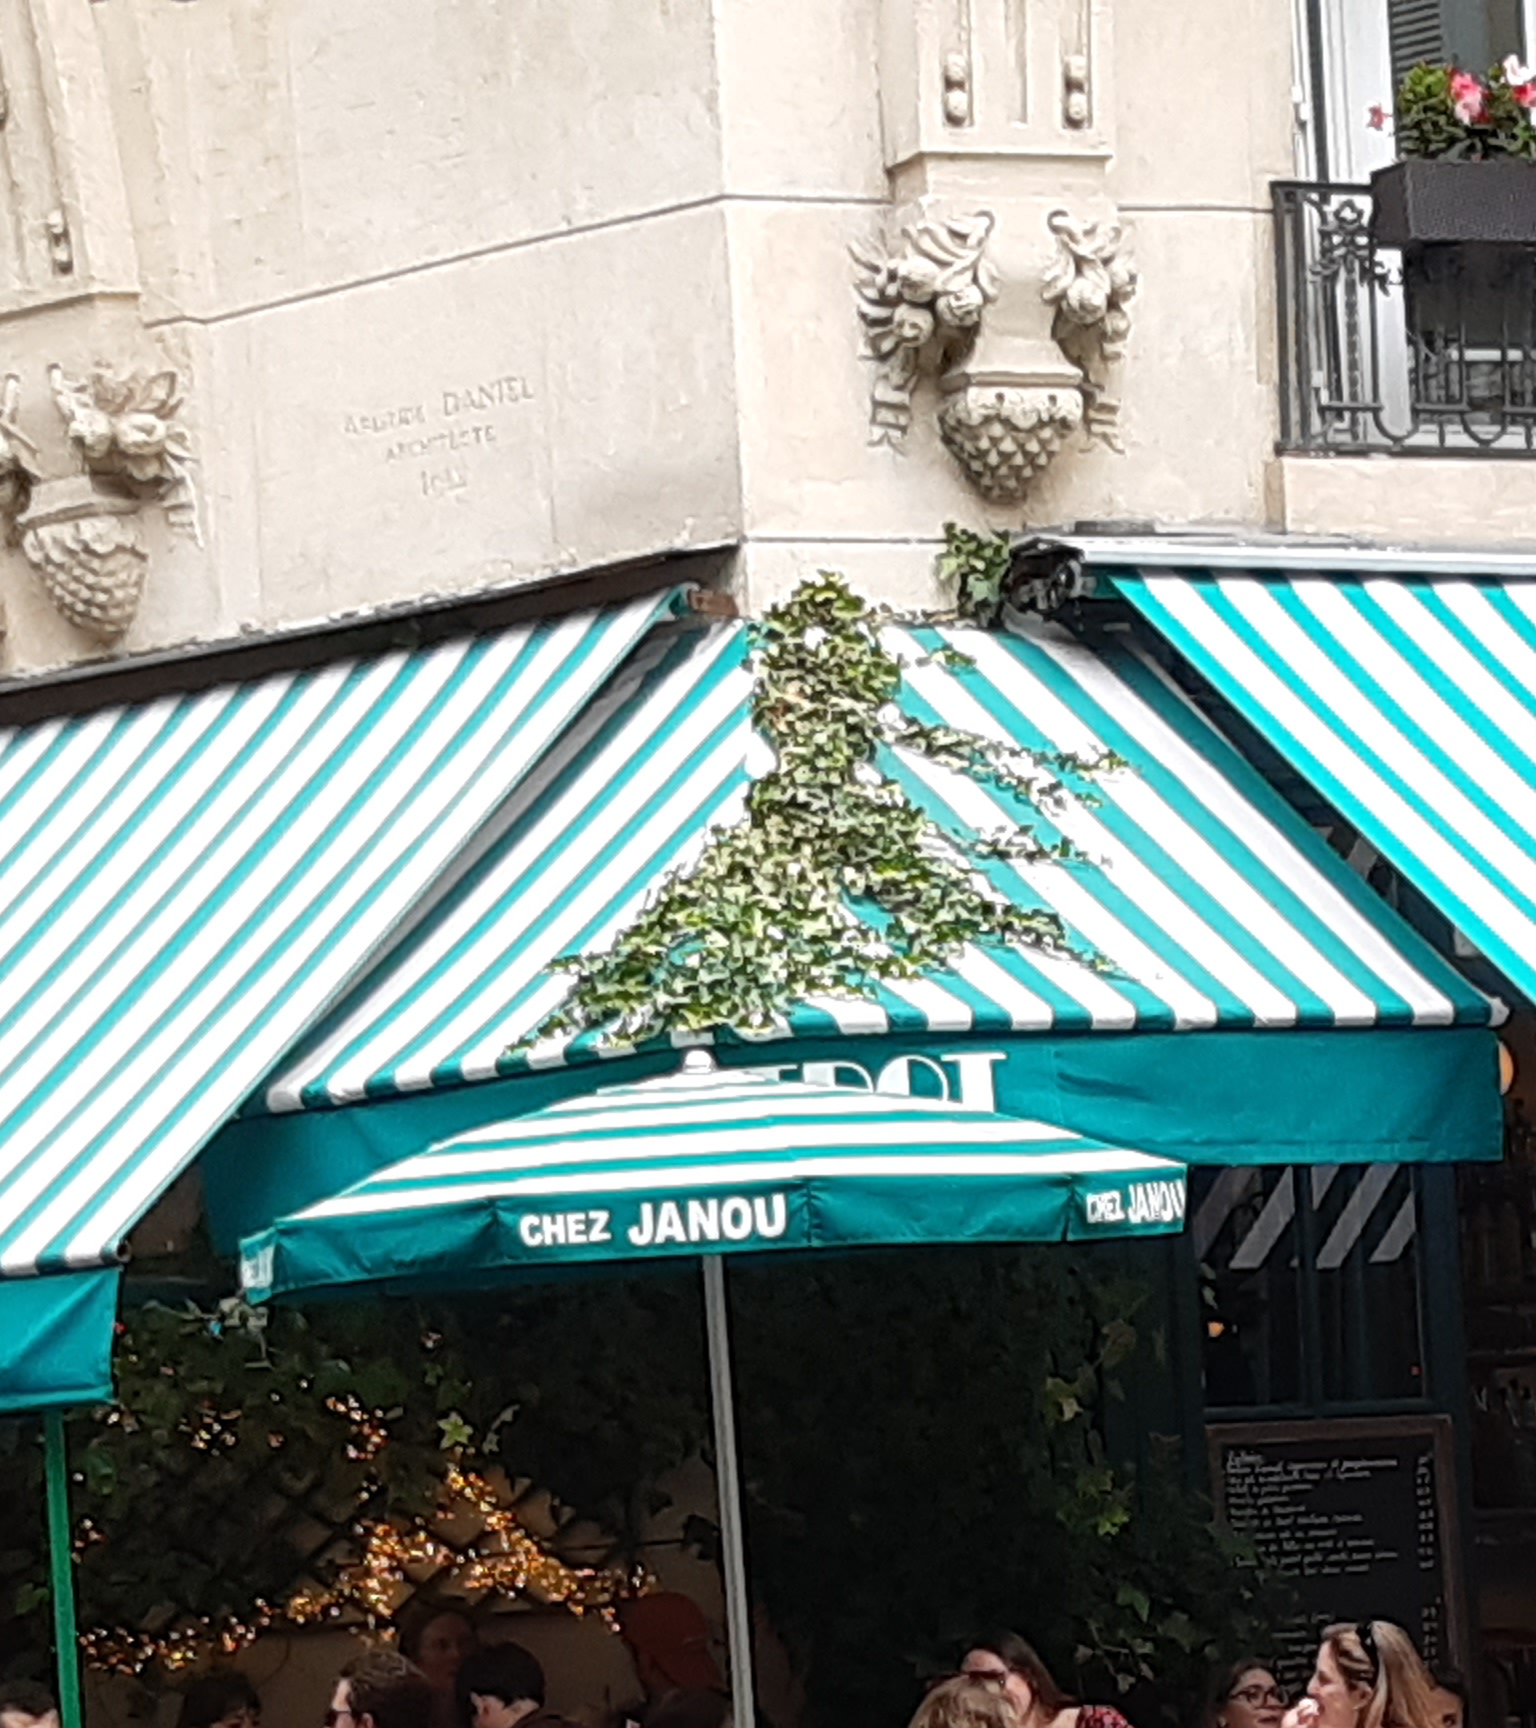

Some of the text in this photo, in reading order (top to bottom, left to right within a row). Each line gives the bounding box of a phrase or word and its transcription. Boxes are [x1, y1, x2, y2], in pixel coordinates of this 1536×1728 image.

[442, 376, 535, 417] DANIEL
[519, 1193, 787, 1247] CHEZ JANOU
